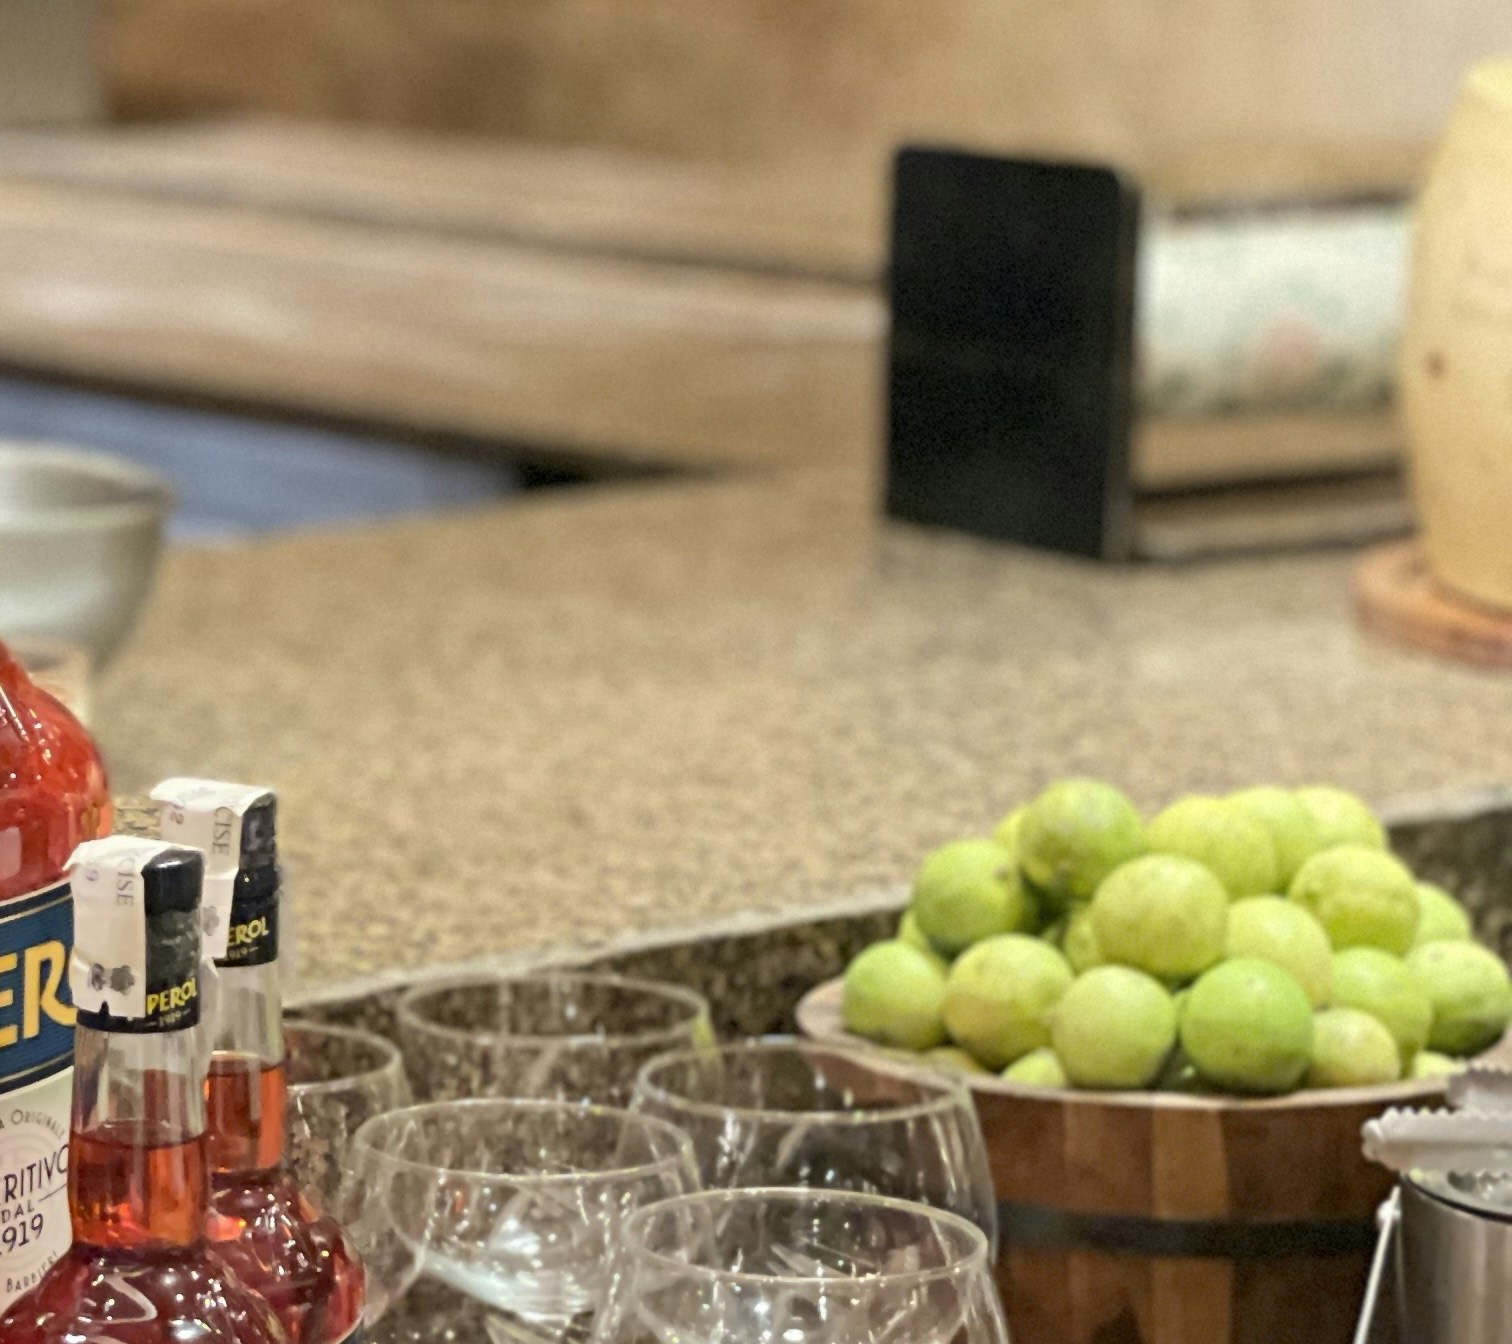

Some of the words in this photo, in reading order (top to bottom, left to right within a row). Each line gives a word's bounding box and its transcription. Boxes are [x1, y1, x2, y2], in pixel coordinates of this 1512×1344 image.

[213, 807, 233, 856] CISE
[147, 977, 197, 1016] PEROL
[0, 1199, 36, 1224] DAL
